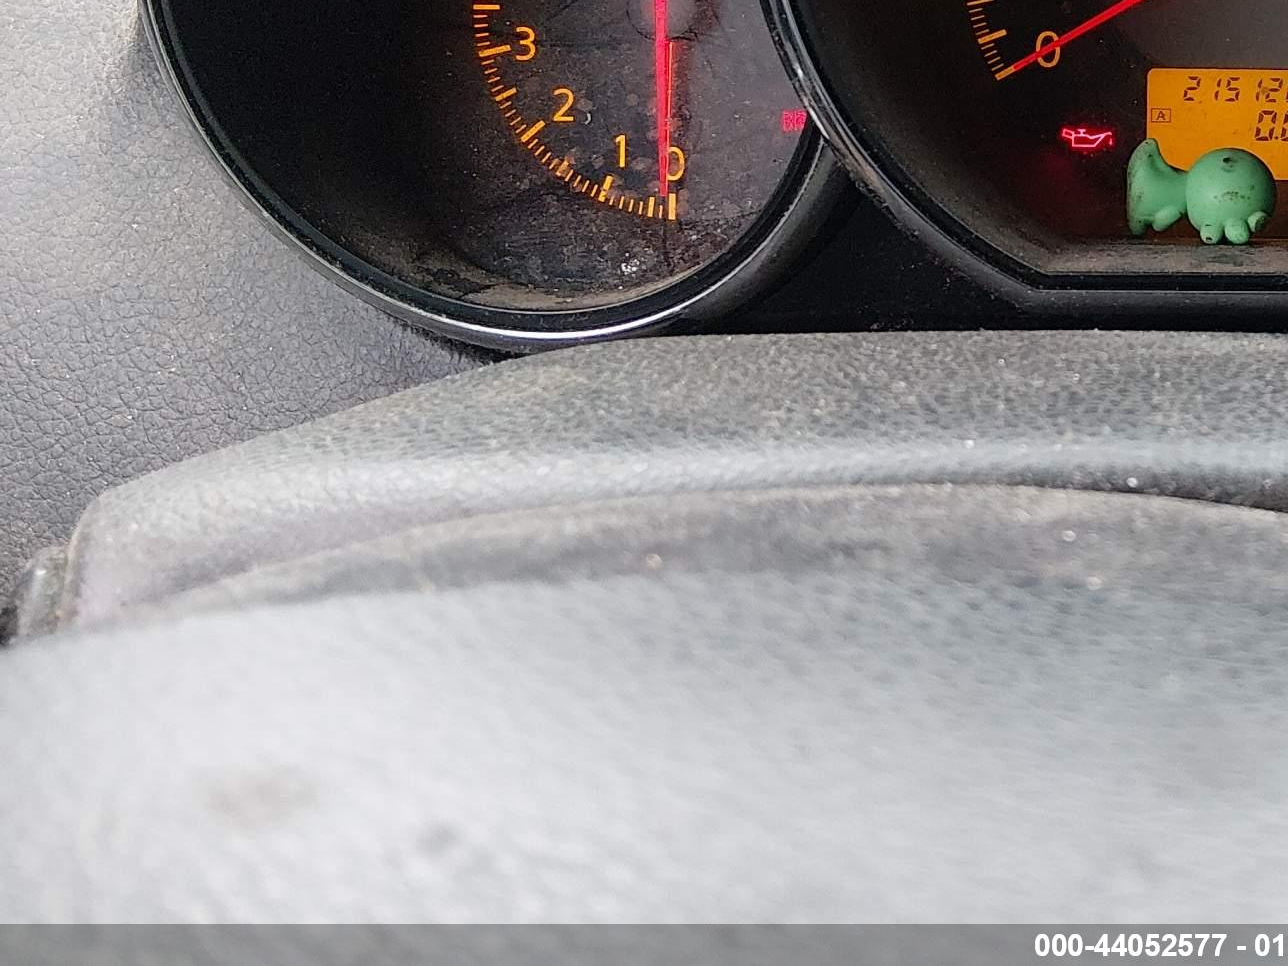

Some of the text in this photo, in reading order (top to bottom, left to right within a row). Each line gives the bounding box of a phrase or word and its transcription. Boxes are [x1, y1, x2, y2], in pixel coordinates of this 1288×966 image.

[515, 27, 535, 60] 3
[1035, 31, 1060, 68] 0
[553, 88, 574, 121] 2
[615, 135, 626, 168] 1
[665, 147, 685, 181] 0
